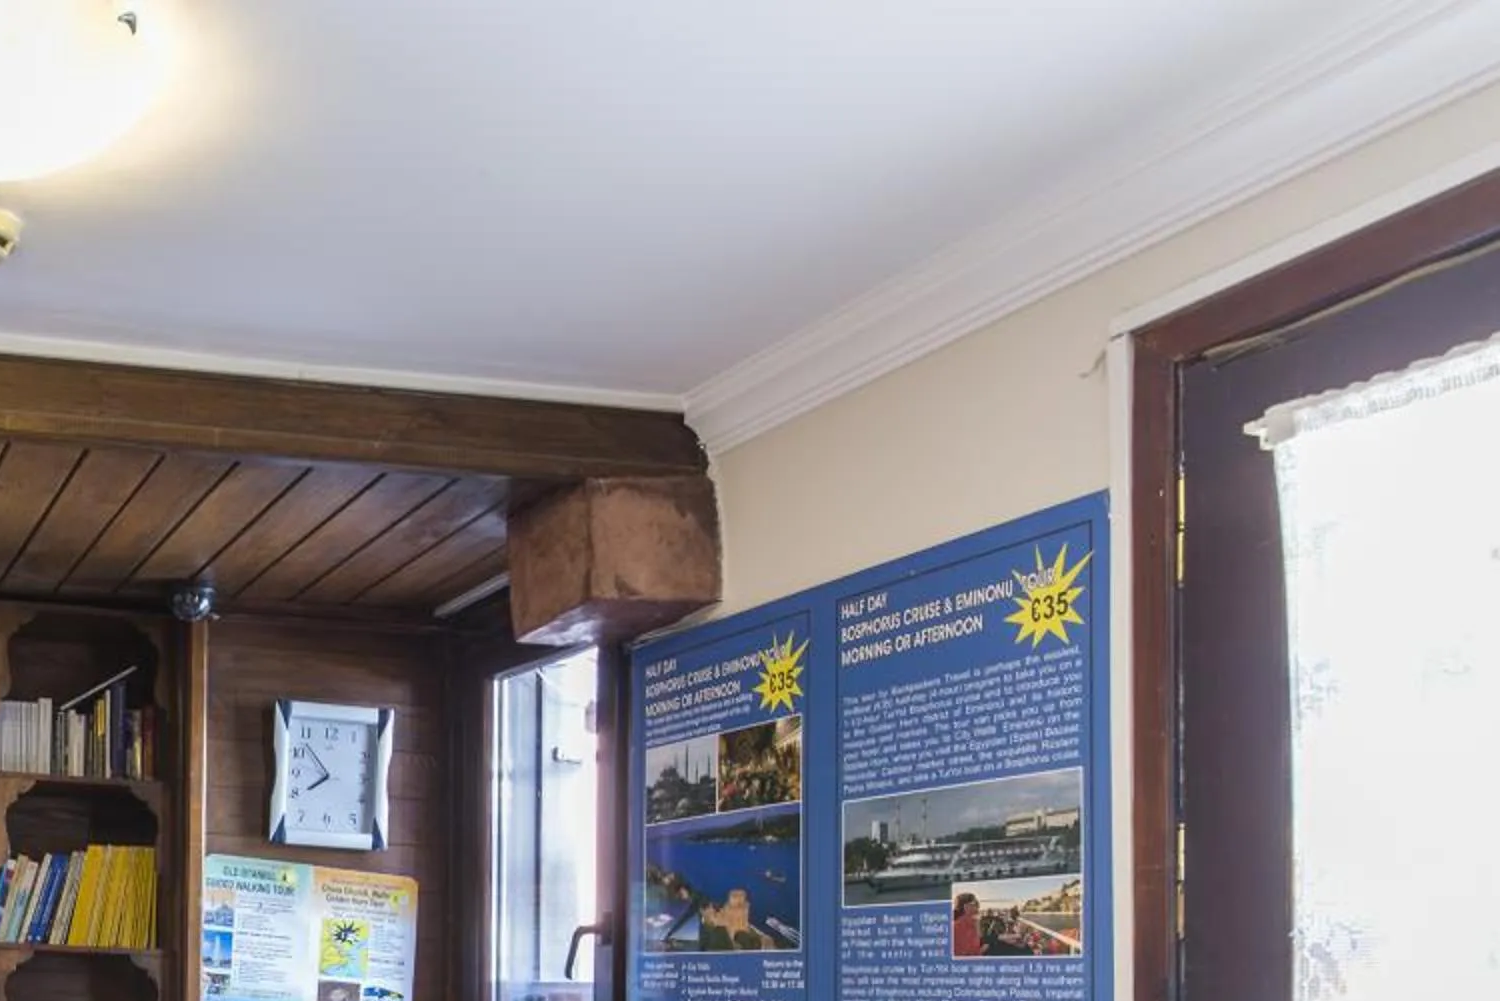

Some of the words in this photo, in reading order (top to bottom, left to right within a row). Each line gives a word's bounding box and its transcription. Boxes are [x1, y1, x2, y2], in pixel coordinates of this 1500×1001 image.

[841, 599, 865, 619] HALF
[867, 592, 887, 612] DAY
[841, 611, 901, 643] BOSPHORUS
[903, 599, 941, 625] CRUISE
[944, 597, 952, 613] &
[956, 579, 1013, 609] EMINONU
[1031, 591, 1069, 622] €35
[841, 638, 892, 667] MORNING
[895, 633, 911, 651] OR
[914, 614, 983, 646] AFTERNOON
[769, 670, 795, 694] €35
[301, 726, 311, 739] 11
[325, 727, 339, 740] 12
[293, 747, 305, 758] 10
[291, 768, 301, 778] 9
[298, 810, 305, 822] 7
